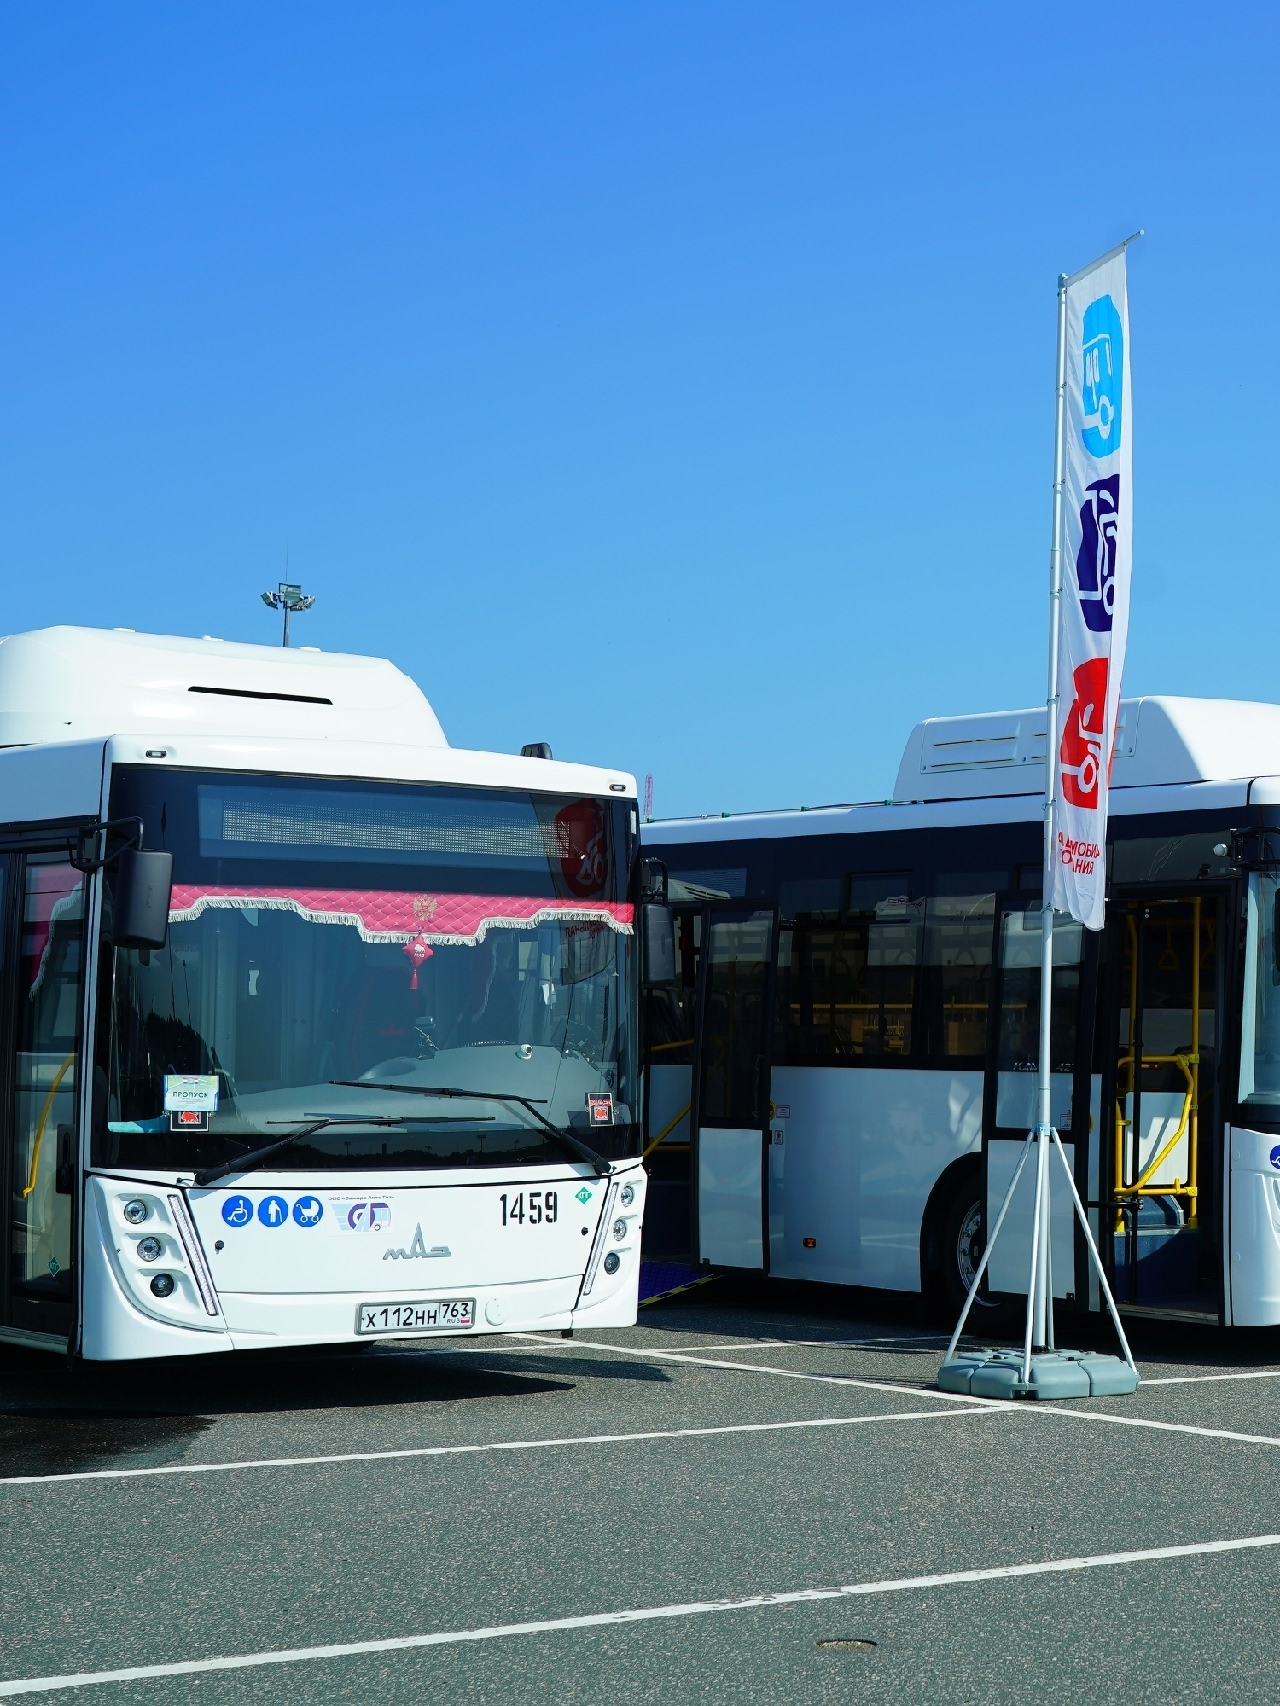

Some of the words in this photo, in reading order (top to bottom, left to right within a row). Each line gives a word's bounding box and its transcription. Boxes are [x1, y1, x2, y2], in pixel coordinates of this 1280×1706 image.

[172, 1091, 209, 1099] ПРОПУСК
[500, 1191, 558, 1226] 1459
[365, 1307, 438, 1328] Х112НН
[442, 1302, 469, 1318] 763
